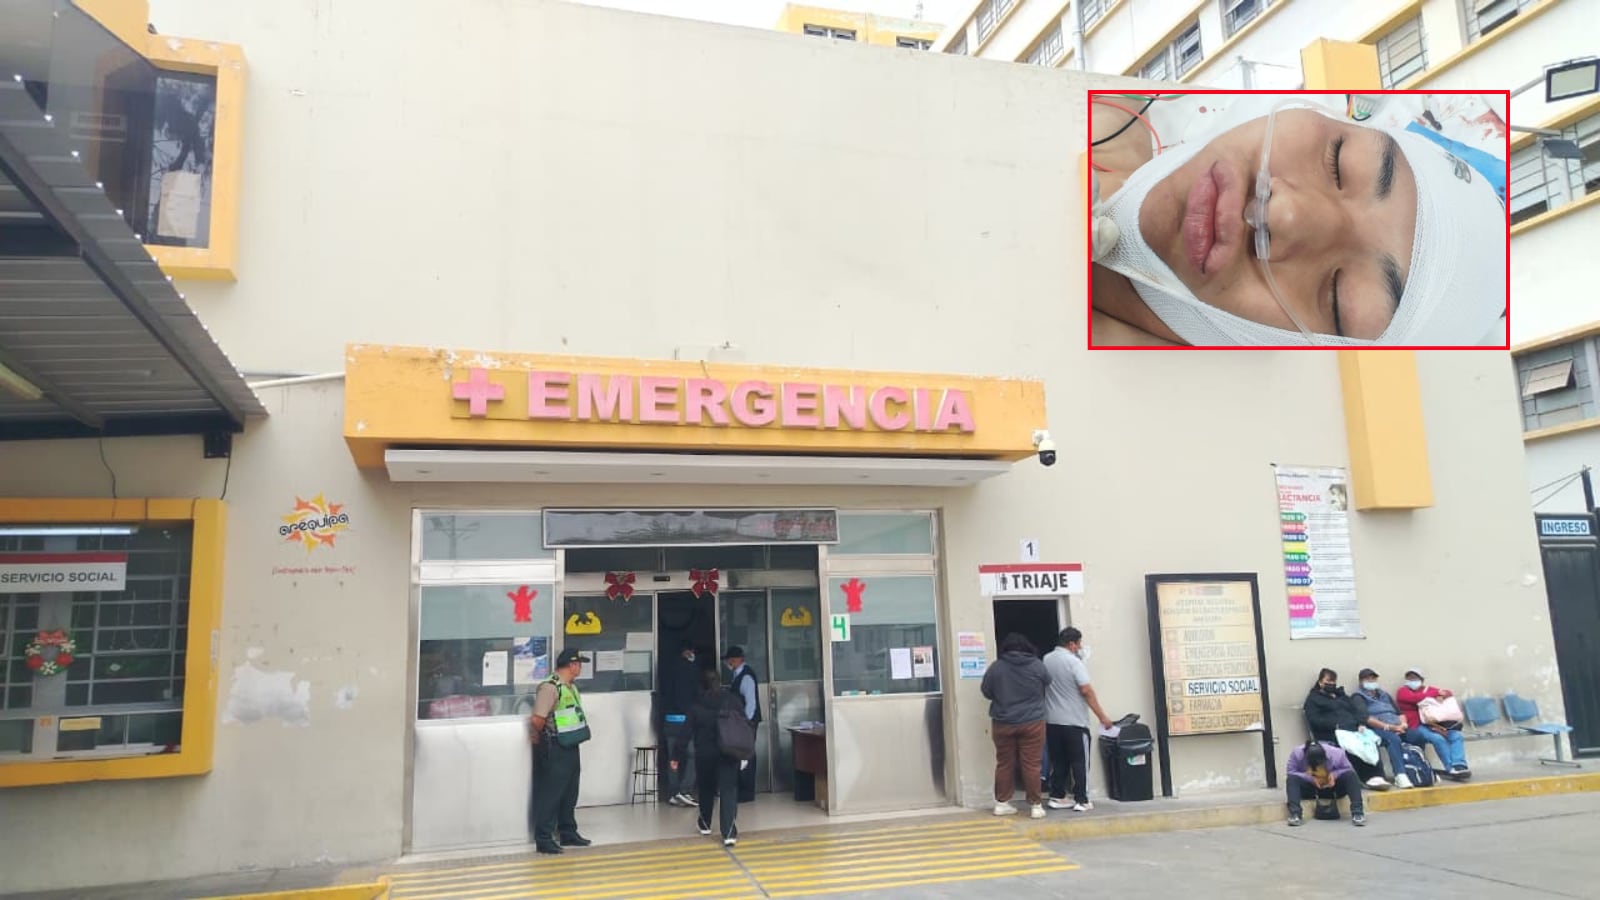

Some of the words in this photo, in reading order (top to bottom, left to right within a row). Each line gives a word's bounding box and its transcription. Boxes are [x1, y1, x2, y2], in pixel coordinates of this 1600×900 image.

[528, 371, 975, 433] EMERGENCIA
[1543, 521, 1587, 533] INGRESO
[1026, 541, 1033, 556] 1
[0, 572, 64, 583] SERVICIO
[69, 572, 117, 582] SOCIAL
[1012, 573, 1068, 592] TRIAJE
[833, 615, 846, 640] 4
[1188, 681, 1226, 695] SERVICIO
[1228, 679, 1258, 692] SOCIAL
